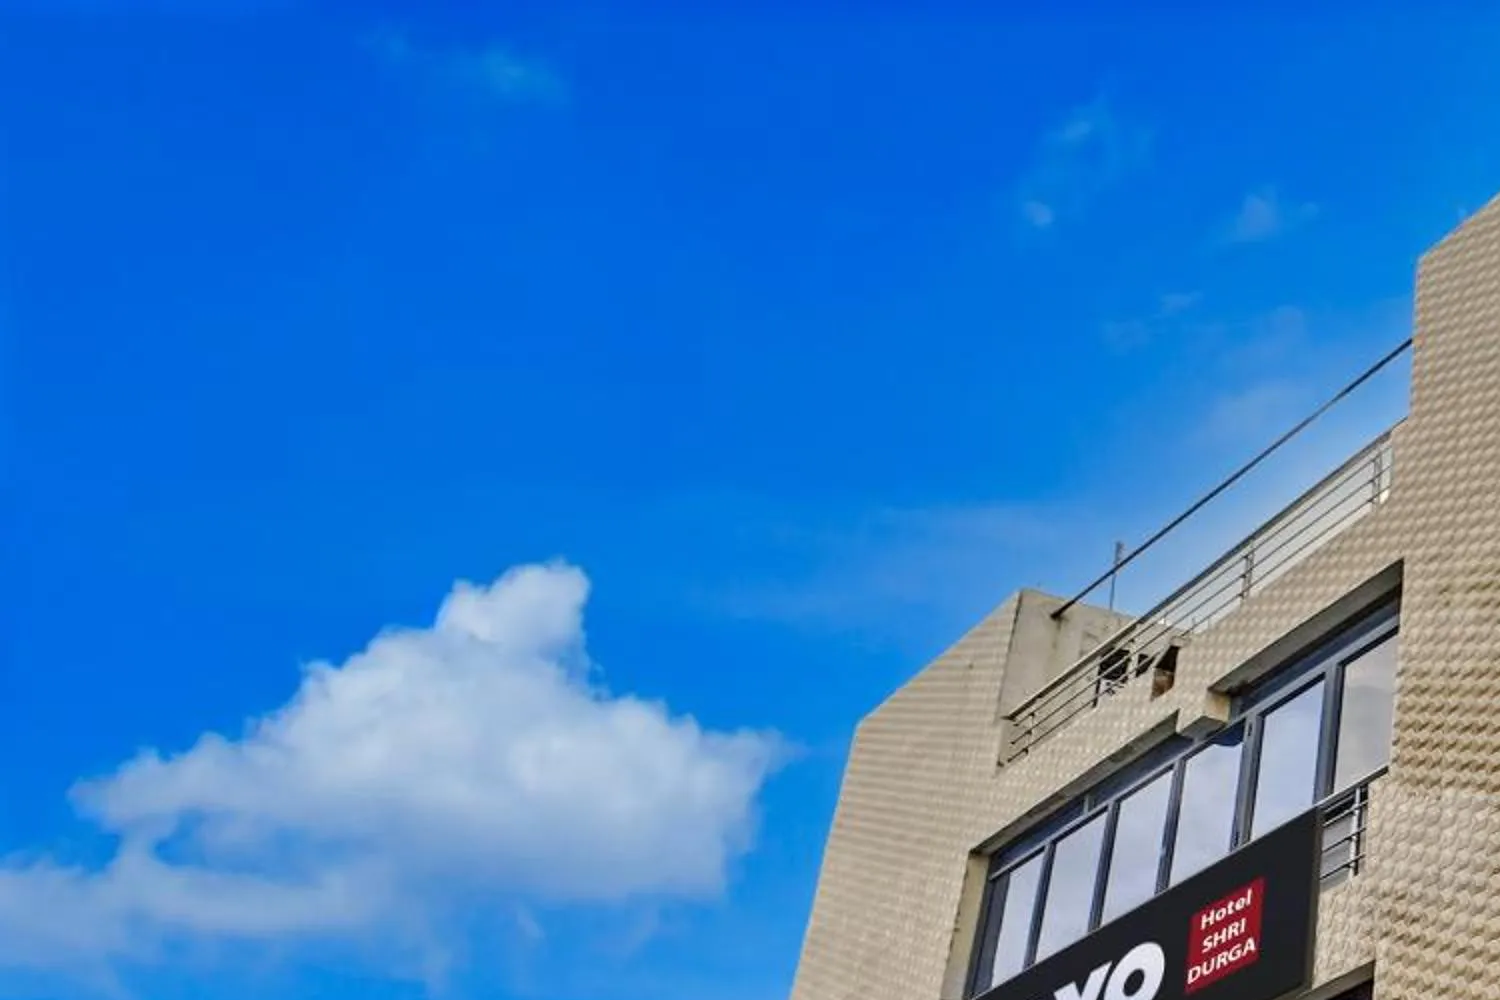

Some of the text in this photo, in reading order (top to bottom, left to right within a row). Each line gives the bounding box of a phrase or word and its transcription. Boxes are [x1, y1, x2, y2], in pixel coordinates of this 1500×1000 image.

[1201, 889, 1252, 930] Hotel
[1202, 919, 1245, 953] SHRI
[1187, 938, 1256, 984] DURGA
